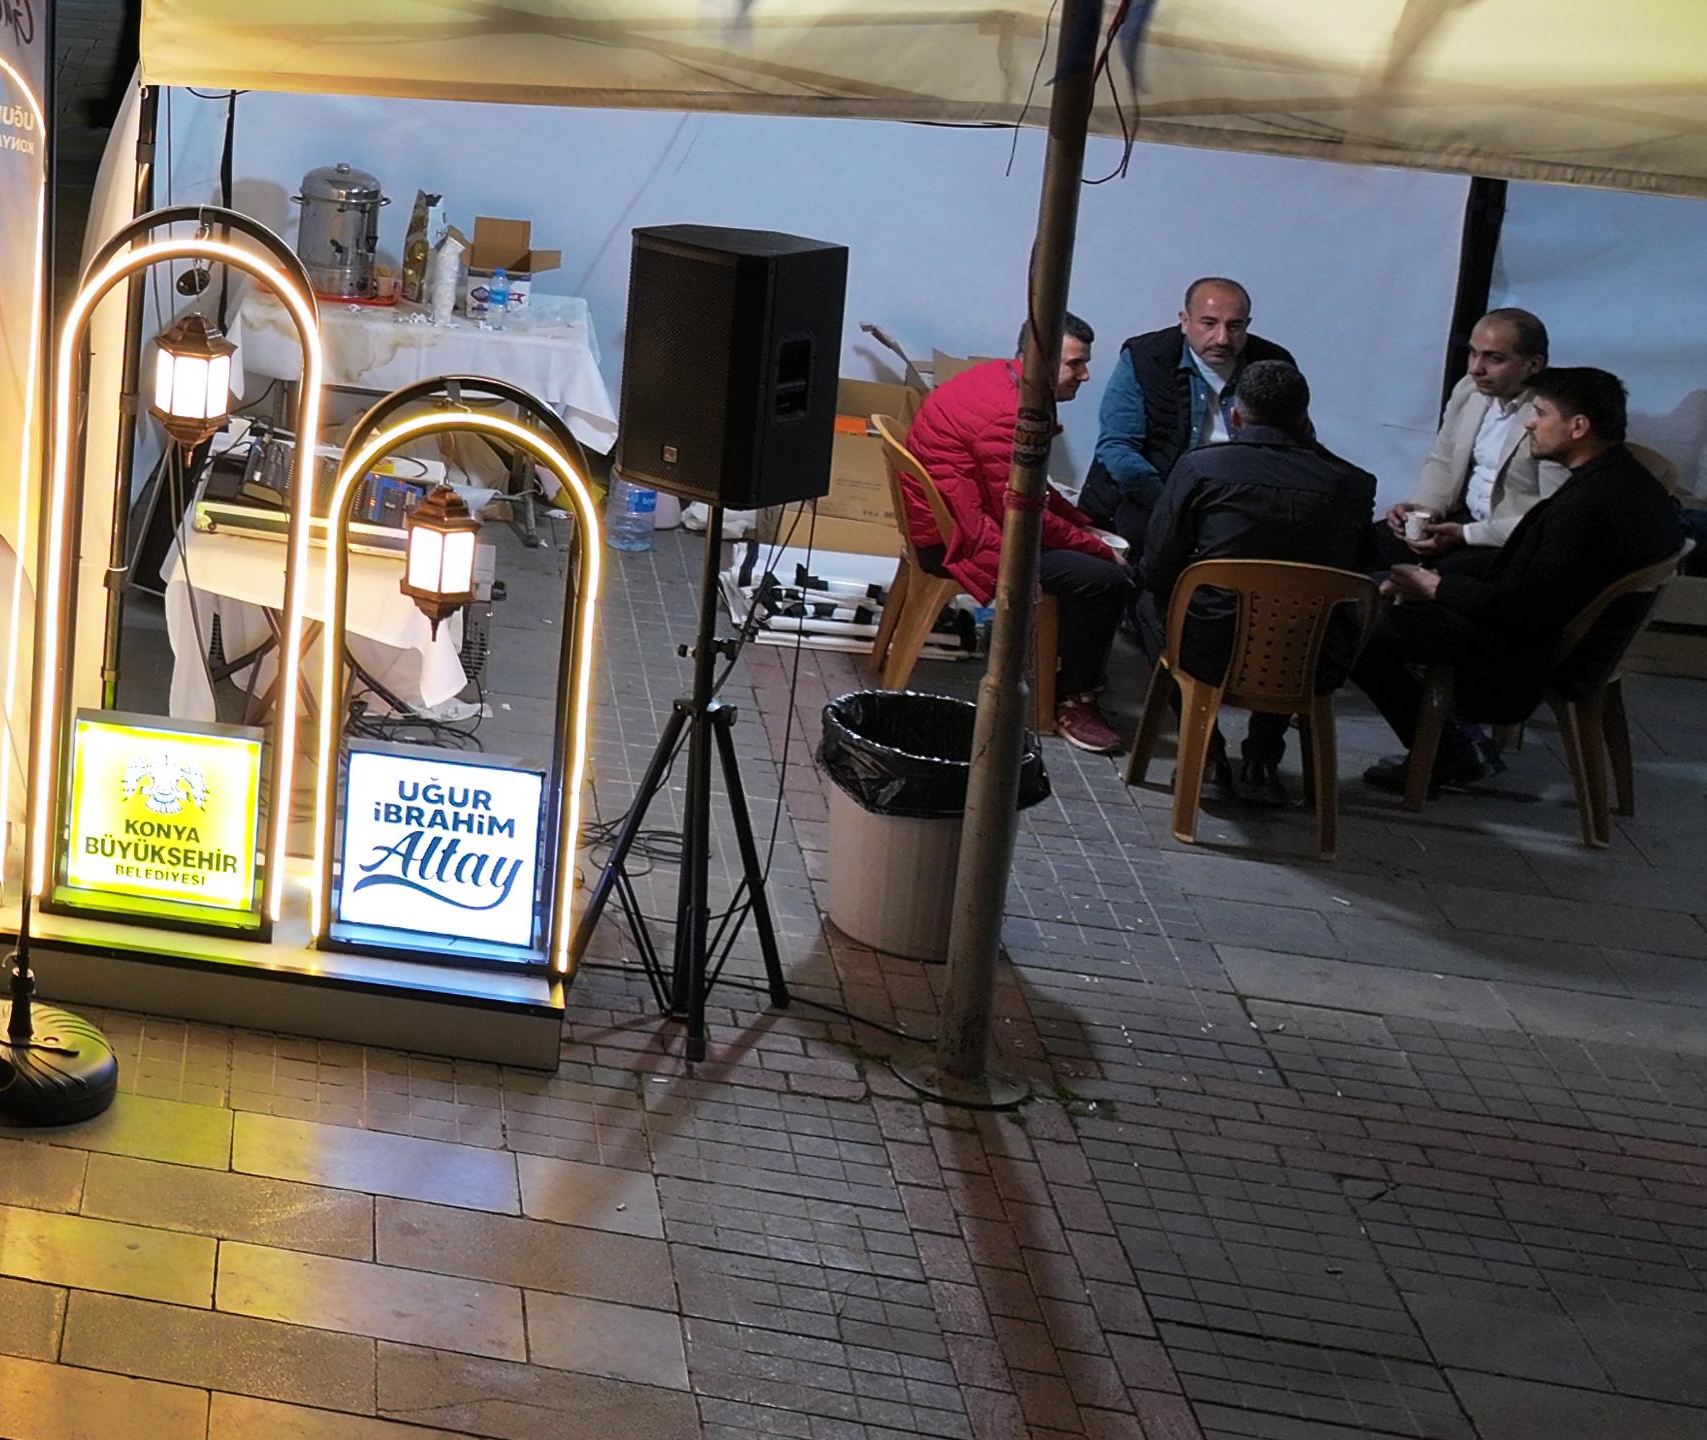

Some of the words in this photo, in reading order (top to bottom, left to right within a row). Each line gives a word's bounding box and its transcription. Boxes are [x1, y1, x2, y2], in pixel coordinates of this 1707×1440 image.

[398, 776, 493, 812] UĞUR
[124, 818, 201, 844] KONYA
[84, 833, 238, 874] BÜYÜKŞEHİR
[353, 830, 525, 911] Altay
